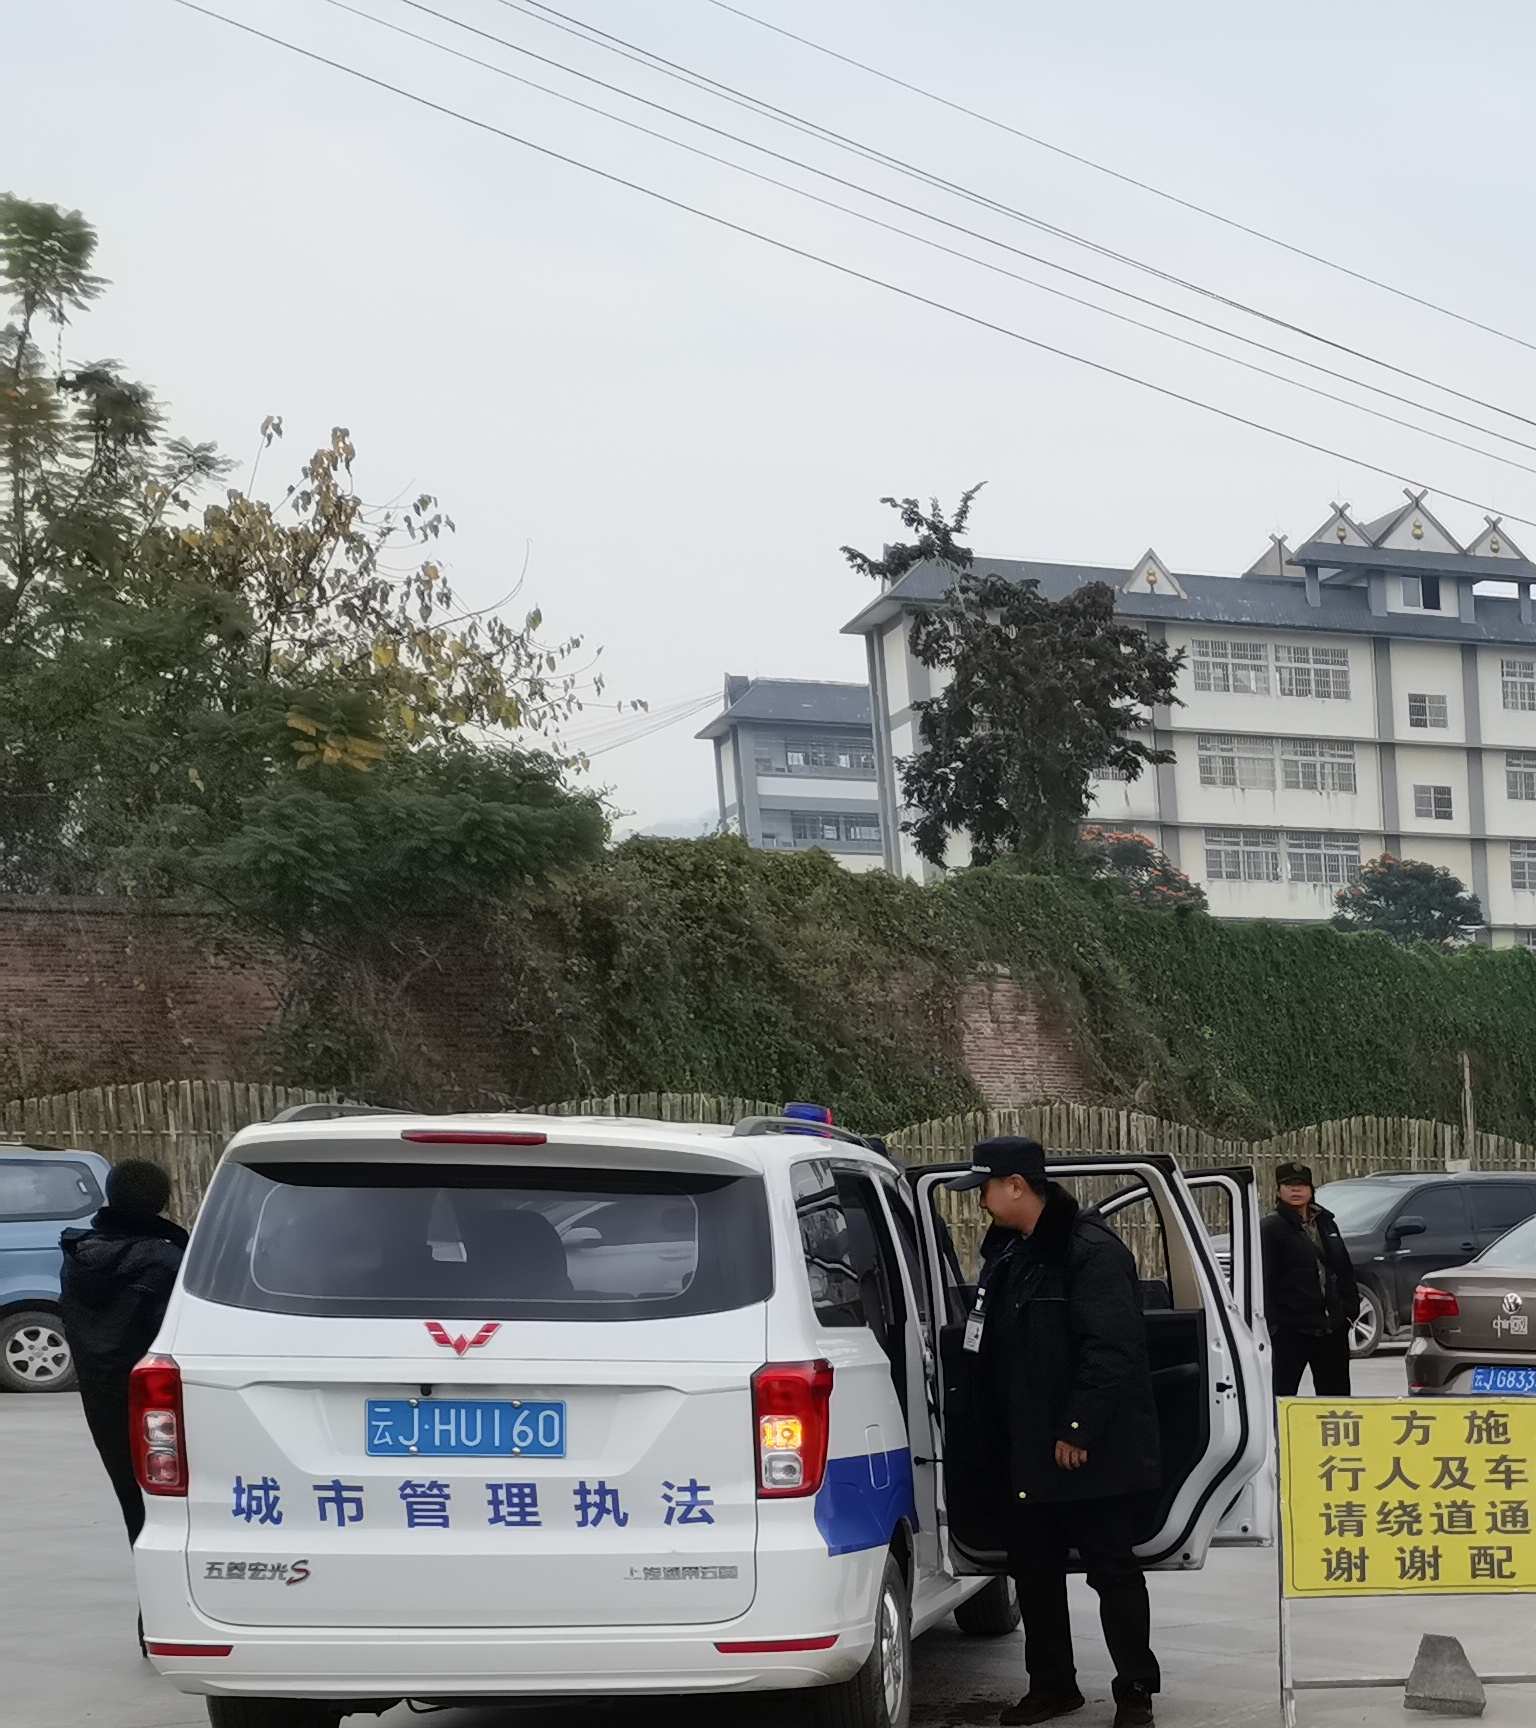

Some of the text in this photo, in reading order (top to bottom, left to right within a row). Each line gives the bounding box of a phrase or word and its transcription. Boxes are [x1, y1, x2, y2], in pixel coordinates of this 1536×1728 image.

[232, 1475, 716, 1529] 城市管理执法
